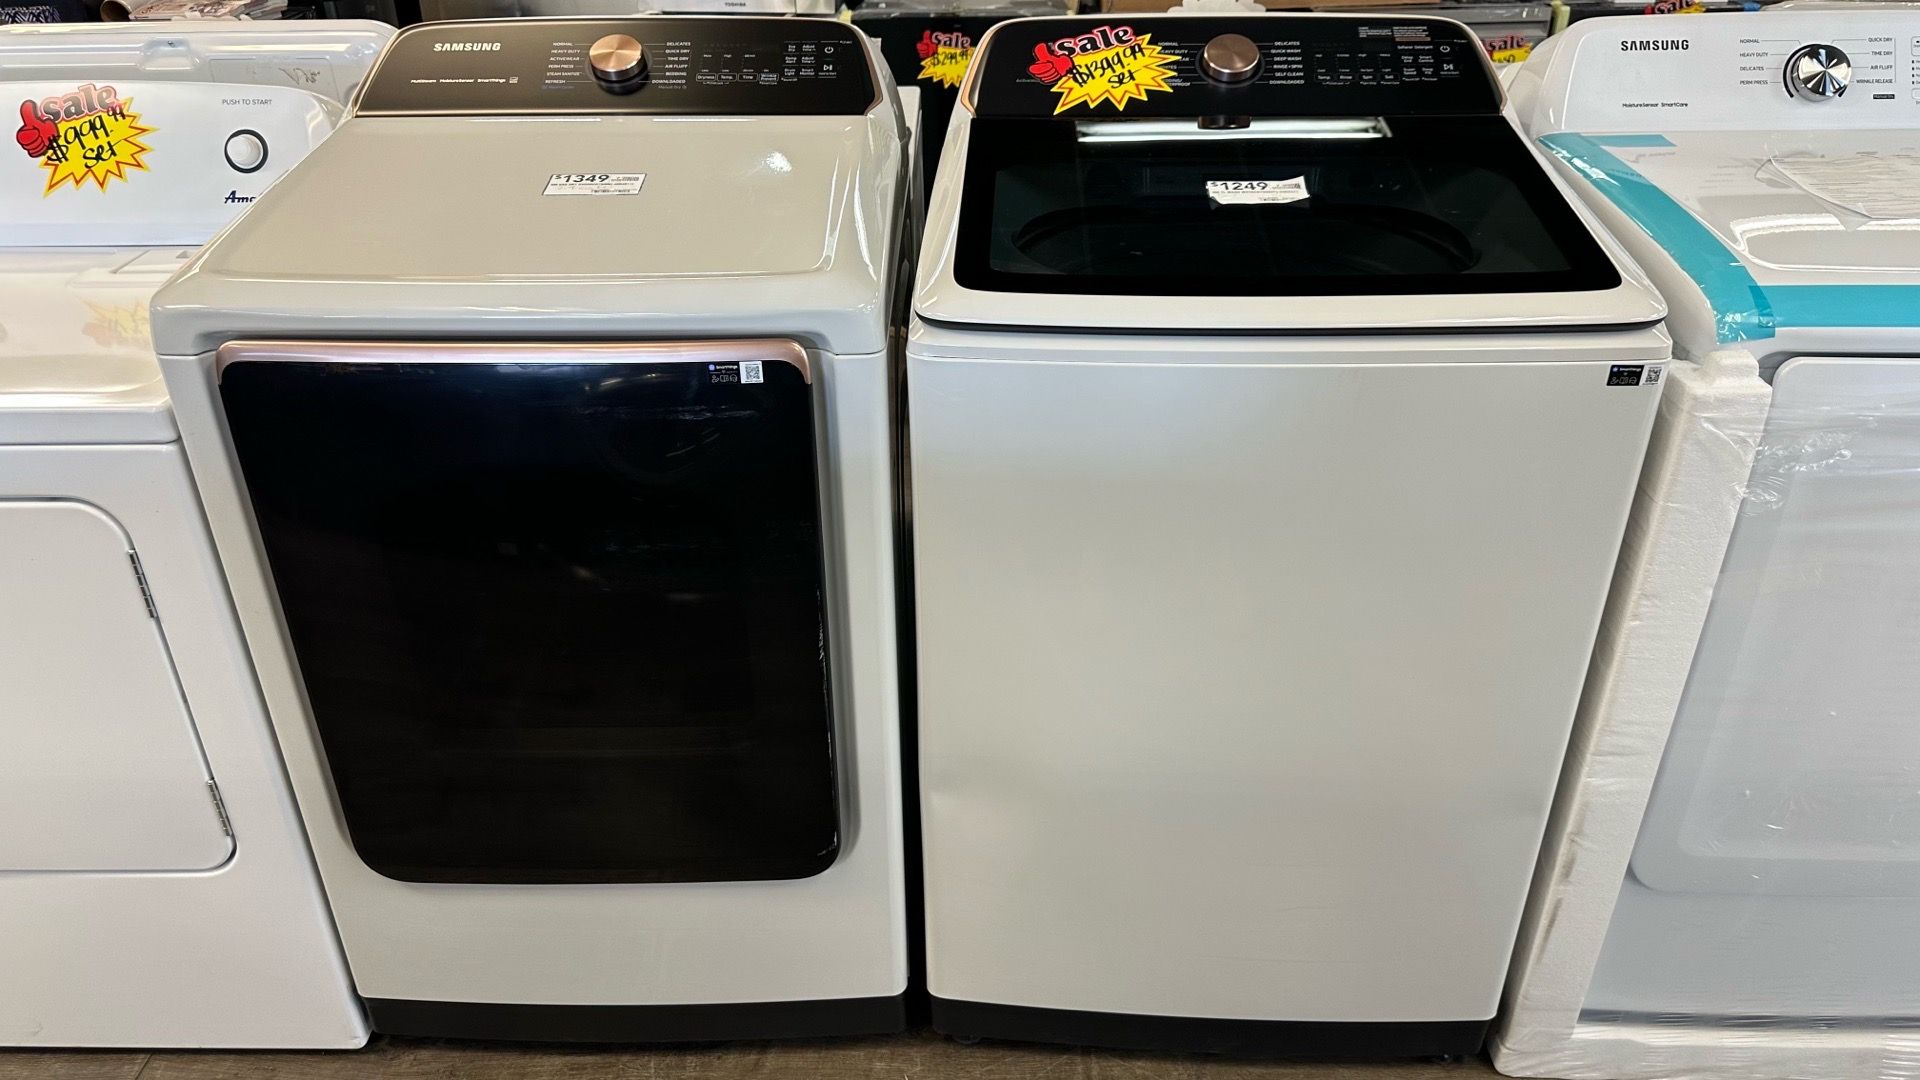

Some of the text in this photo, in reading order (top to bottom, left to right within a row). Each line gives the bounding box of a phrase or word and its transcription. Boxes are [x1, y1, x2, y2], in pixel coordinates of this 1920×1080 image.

[433, 42, 502, 52] SAMSUNG
[1620, 39, 1690, 51] SAMSUNG
[40, 83, 119, 123] sale
[222, 98, 273, 106] PUSH TO START
[554, 174, 610, 183] $1349
[1210, 181, 1269, 191] $1249
